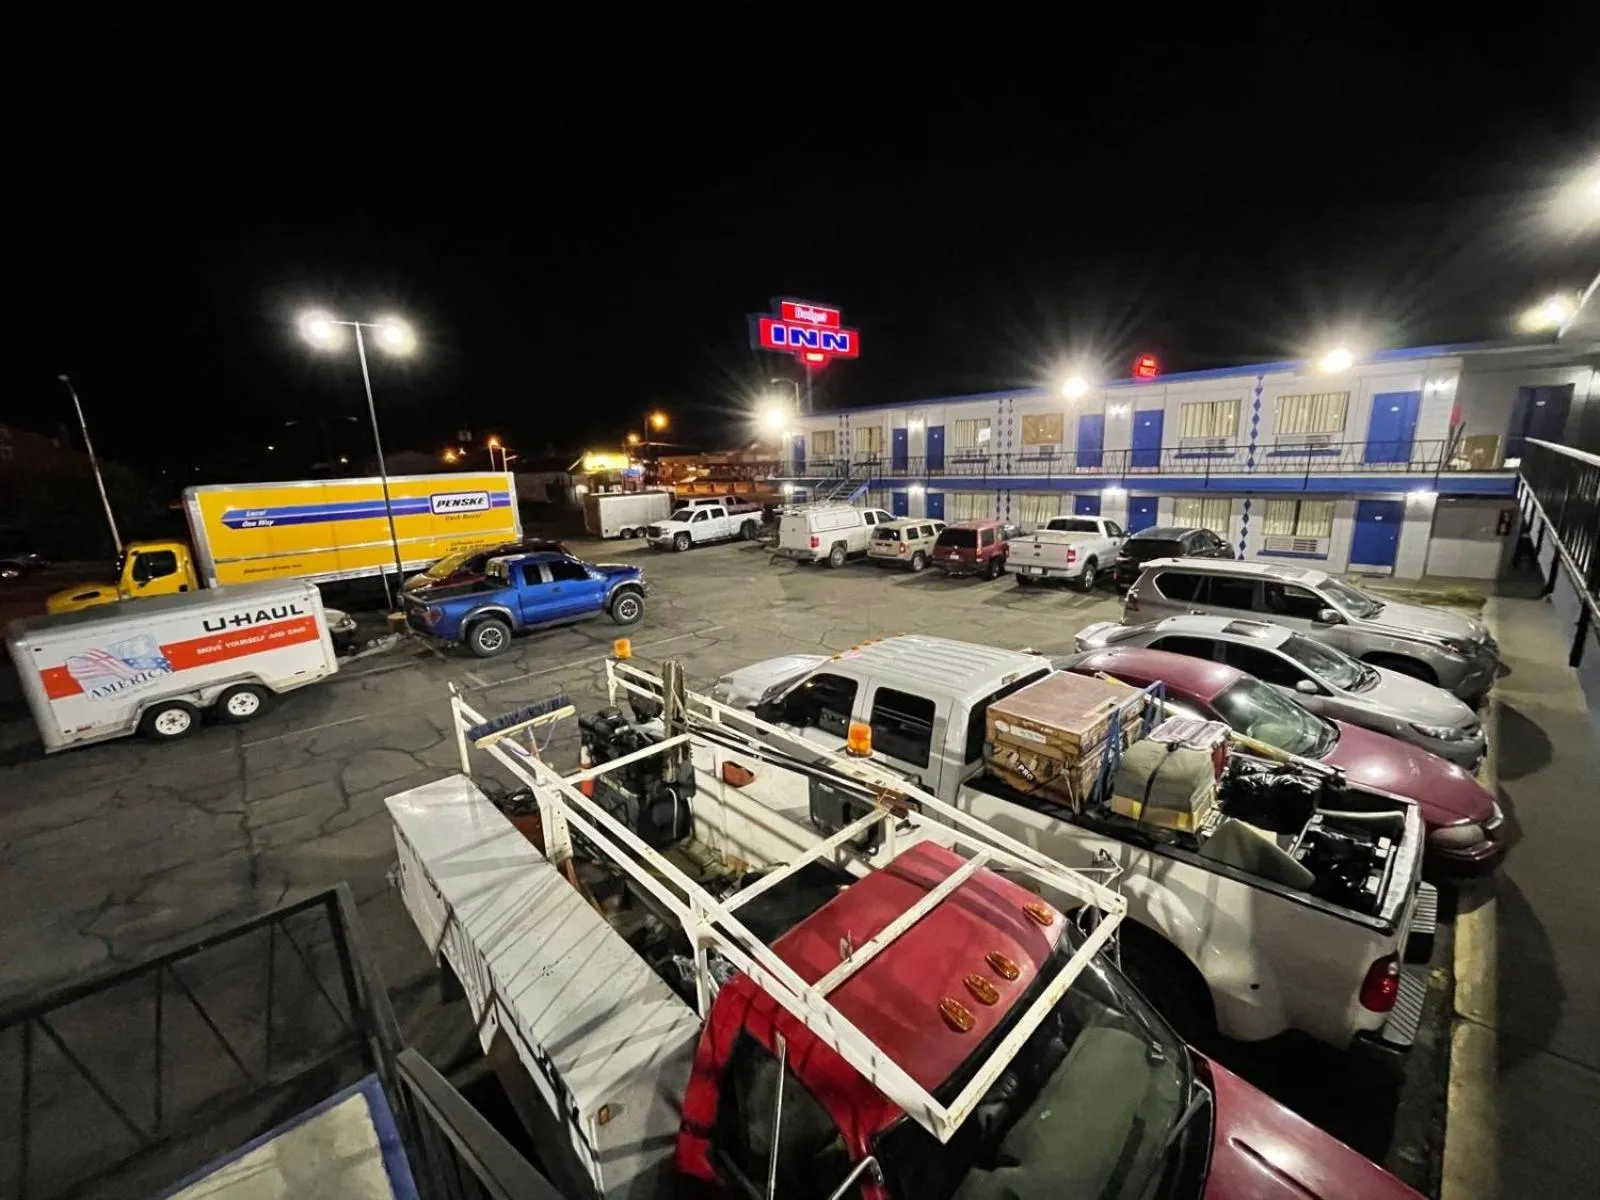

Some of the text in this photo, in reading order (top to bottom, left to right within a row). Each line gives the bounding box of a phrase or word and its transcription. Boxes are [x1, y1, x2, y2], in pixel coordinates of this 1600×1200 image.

[795, 305, 828, 323] Budget
[771, 324, 849, 352] INN
[436, 497, 486, 508] PENSKE
[246, 509, 268, 517] Local
[258, 519, 274, 527] Way
[203, 604, 304, 632] U-HAUL
[196, 644, 223, 655] MOVE
[225, 634, 266, 649] YOURSELF
[268, 631, 286, 639] AND
